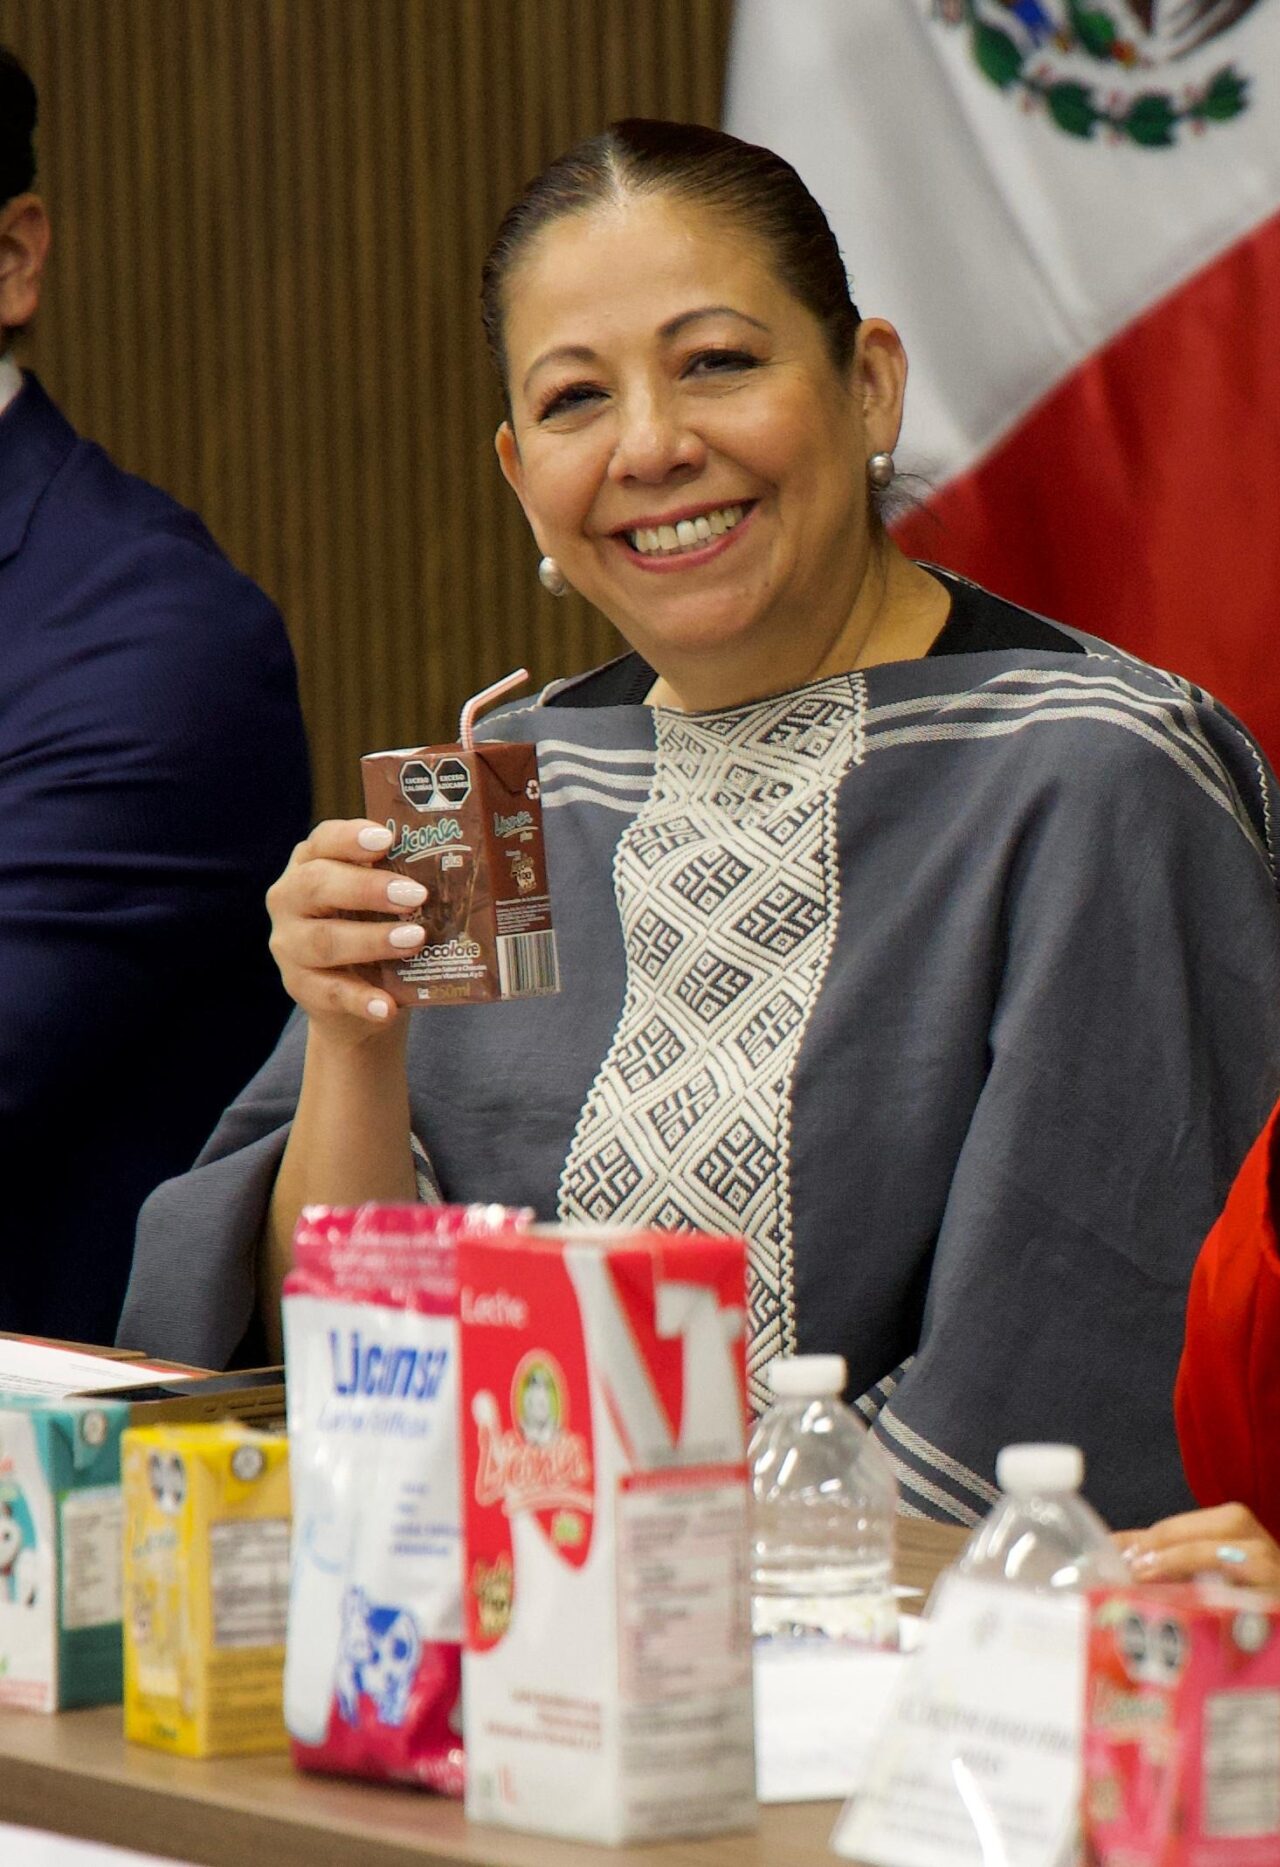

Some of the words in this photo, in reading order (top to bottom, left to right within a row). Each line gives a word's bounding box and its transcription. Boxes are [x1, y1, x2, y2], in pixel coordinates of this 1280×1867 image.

[386, 817, 464, 860] Liconsa
[441, 852, 463, 871] plus
[402, 939, 481, 962] ocolate
